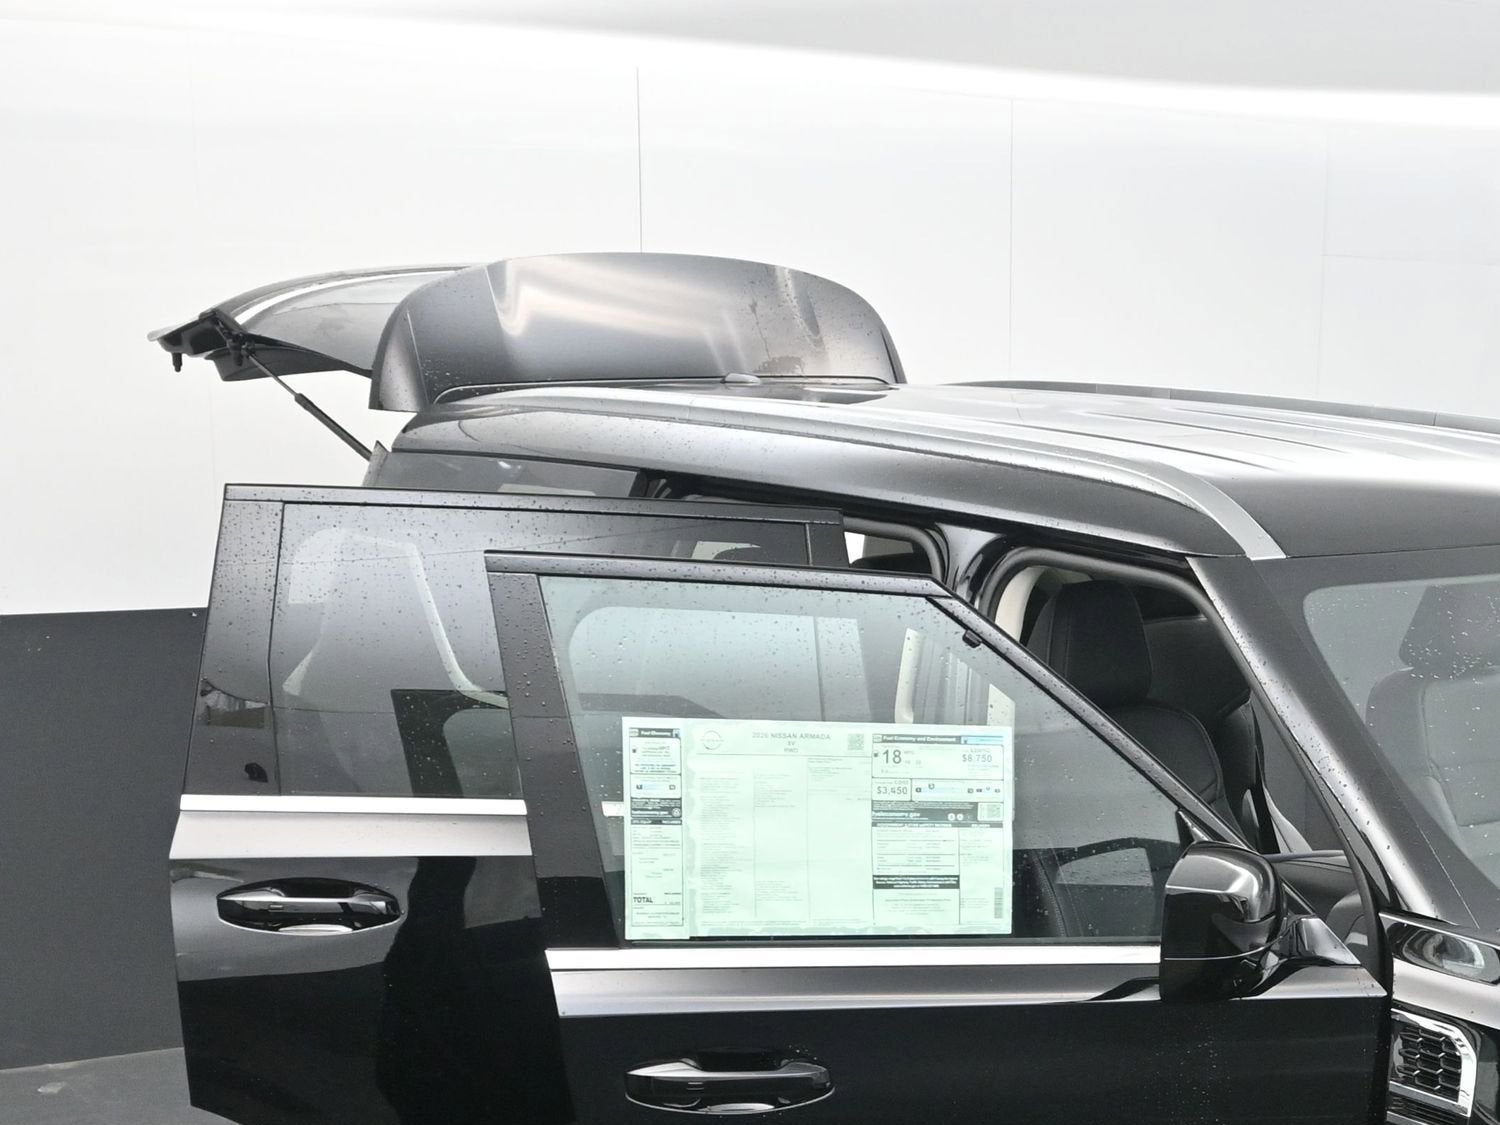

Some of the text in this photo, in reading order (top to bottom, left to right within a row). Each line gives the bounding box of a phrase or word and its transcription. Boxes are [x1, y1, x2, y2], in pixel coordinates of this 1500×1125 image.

[770, 731, 797, 739] NISSAN
[799, 732, 831, 740] ARMADA
[882, 749, 902, 764] 18
[876, 785, 908, 795] $3,450
[633, 896, 653, 904] TOTAL
